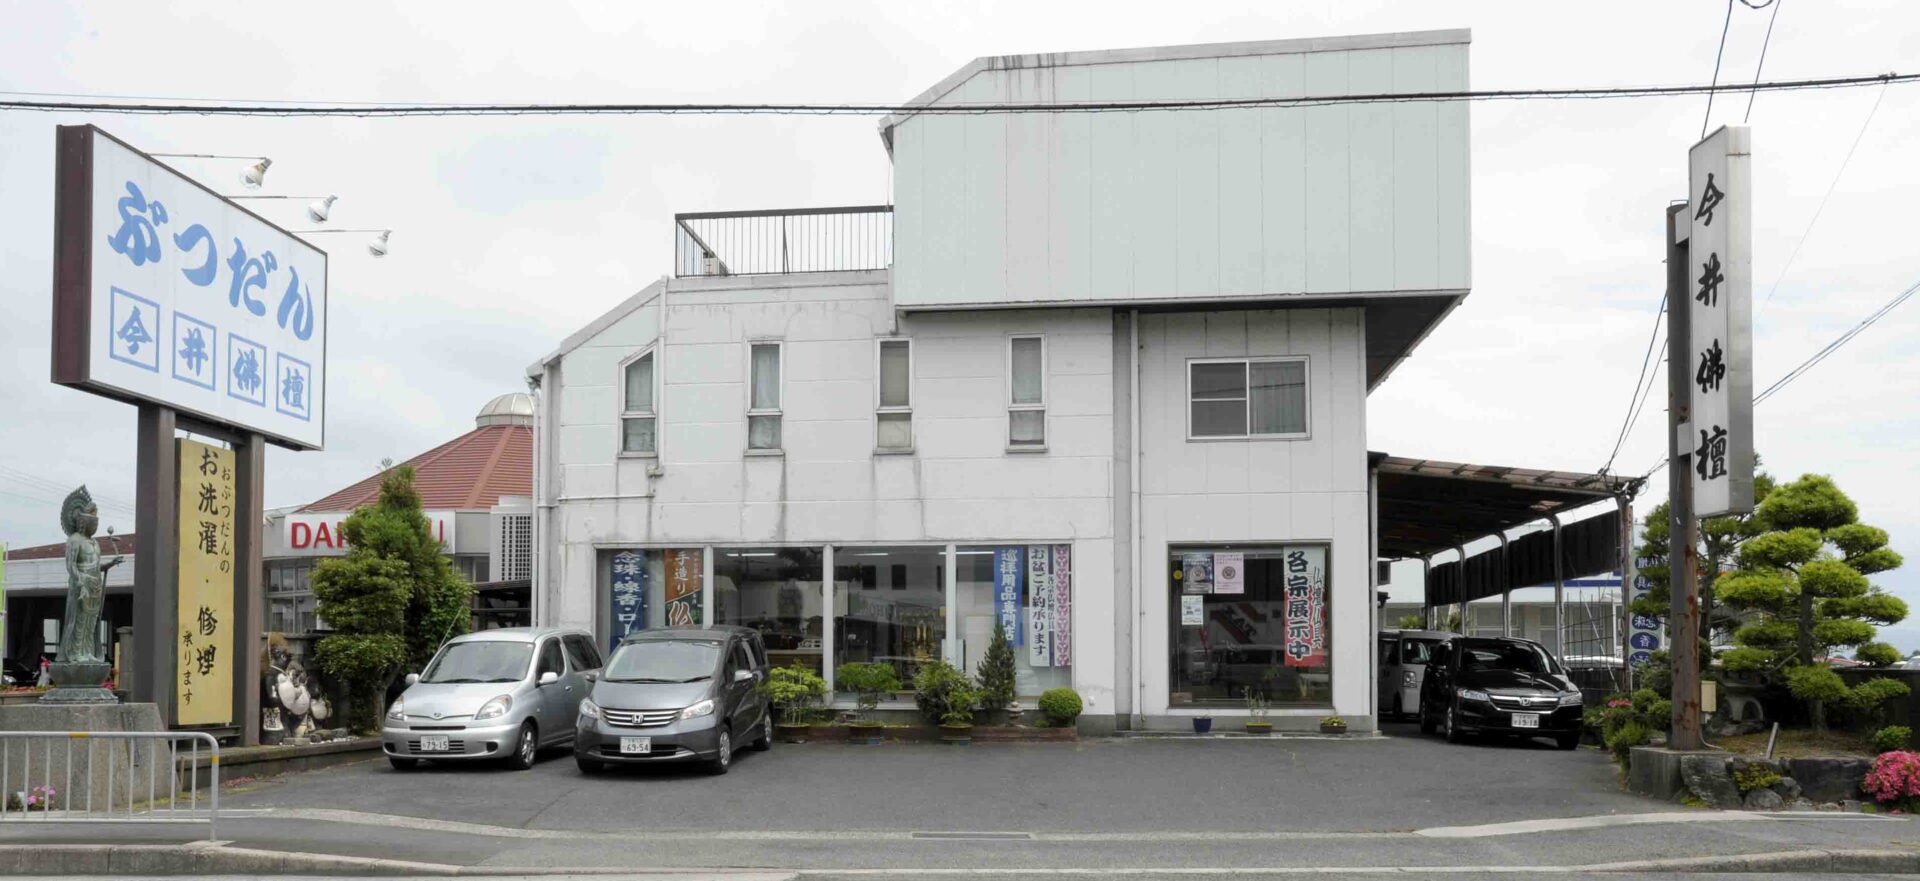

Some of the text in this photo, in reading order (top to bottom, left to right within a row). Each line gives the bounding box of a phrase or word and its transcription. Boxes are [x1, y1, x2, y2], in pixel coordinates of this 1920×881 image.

[108, 180, 315, 341] ぶつだん
[219, 467, 231, 573] おぶつだんの
[674, 551, 690, 595] 手造り
[613, 551, 641, 641] 念珠・線香・ロー
[1031, 548, 1046, 656] お盆ご予約承ります
[1287, 550, 1311, 659] 各宗展示中
[181, 631, 193, 704] 承ります
